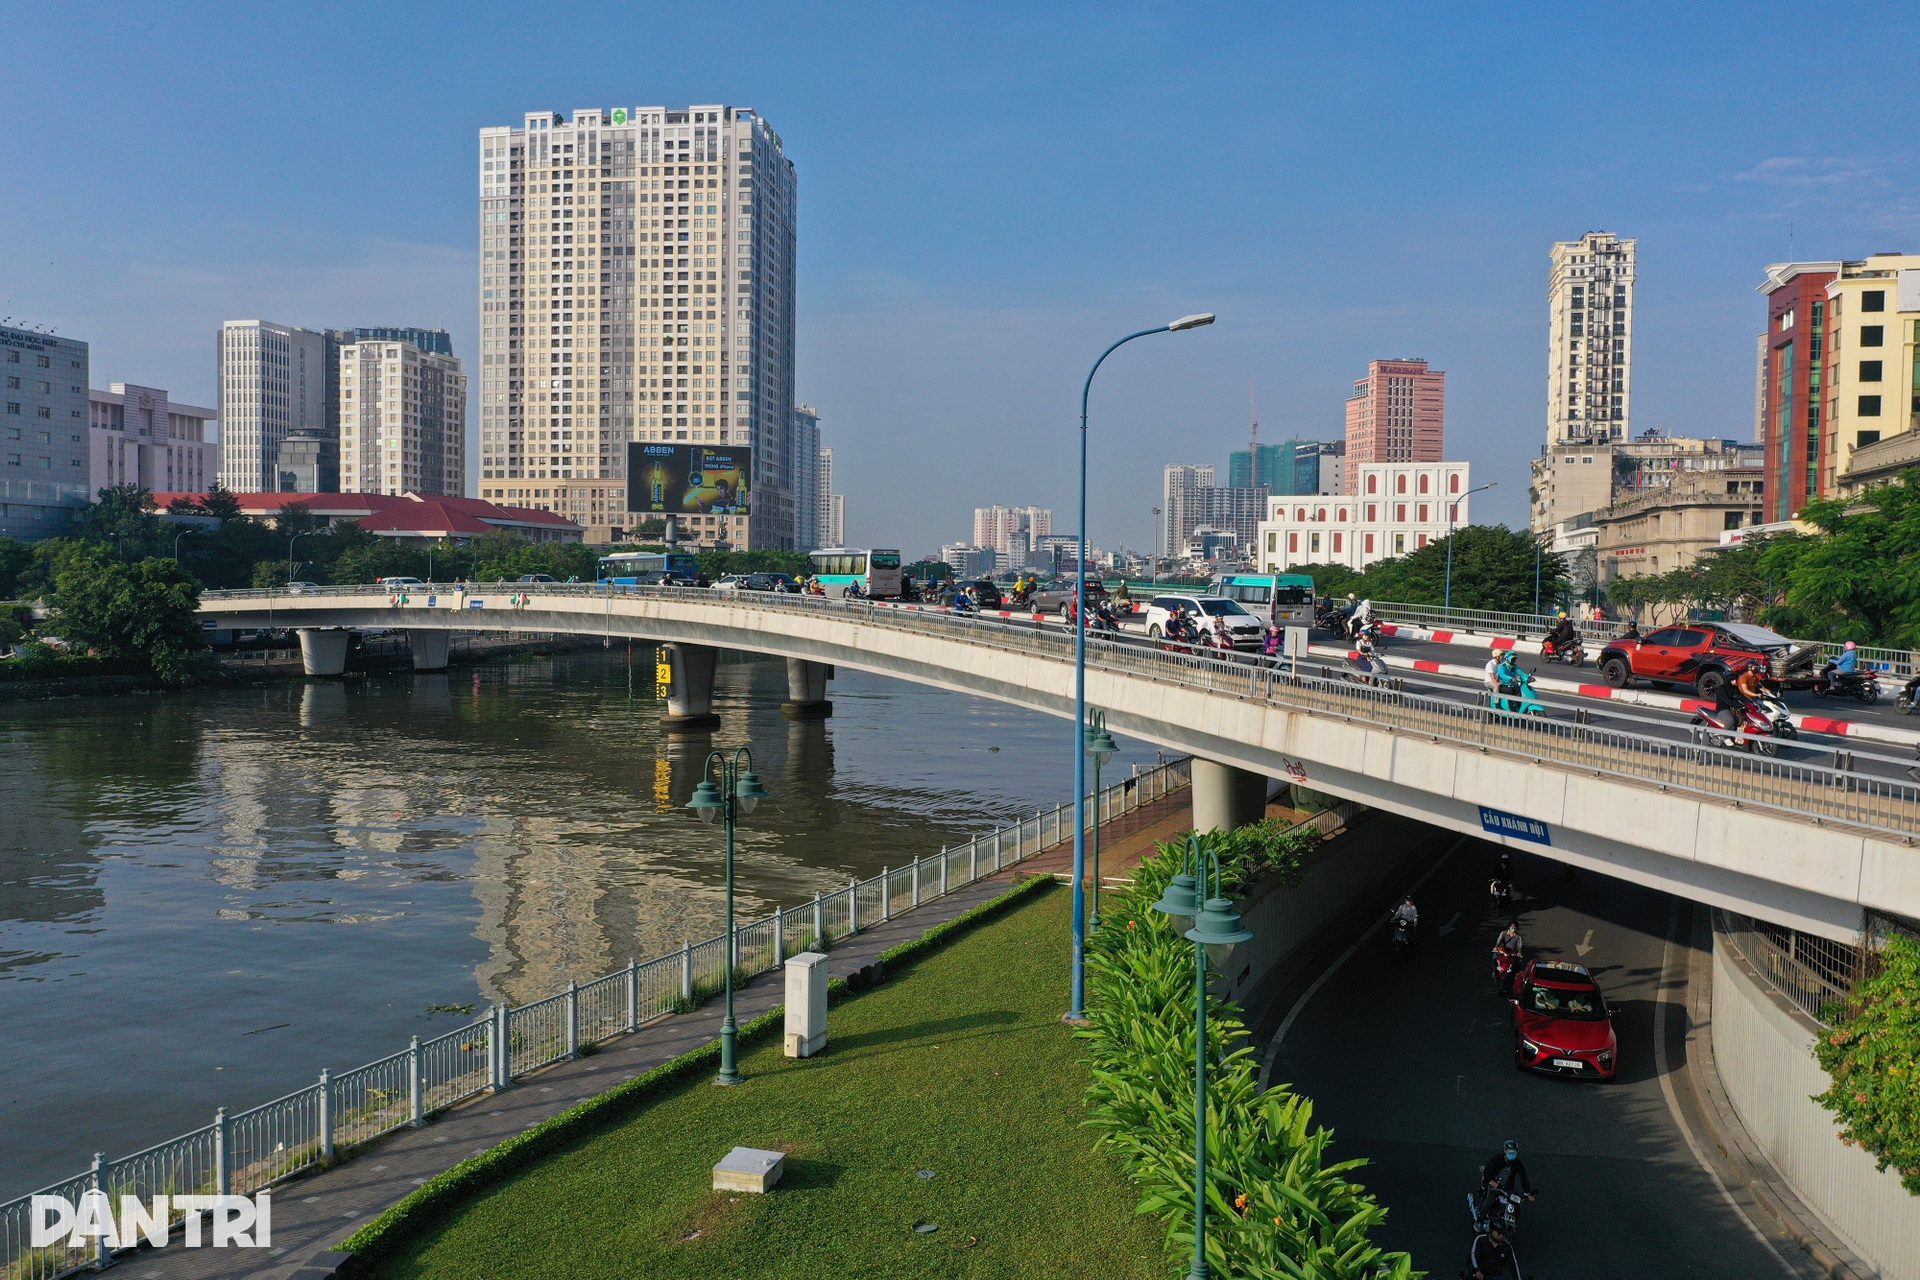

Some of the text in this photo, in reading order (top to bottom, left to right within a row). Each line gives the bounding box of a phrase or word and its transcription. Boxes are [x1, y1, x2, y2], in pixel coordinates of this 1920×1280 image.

[644, 446, 674, 454] ABBEN
[661, 650, 666, 661] 1
[661, 668, 666, 679] 2
[660, 686, 667, 697] 3
[1483, 809, 1544, 837] CẦU KHÁNH HỘI
